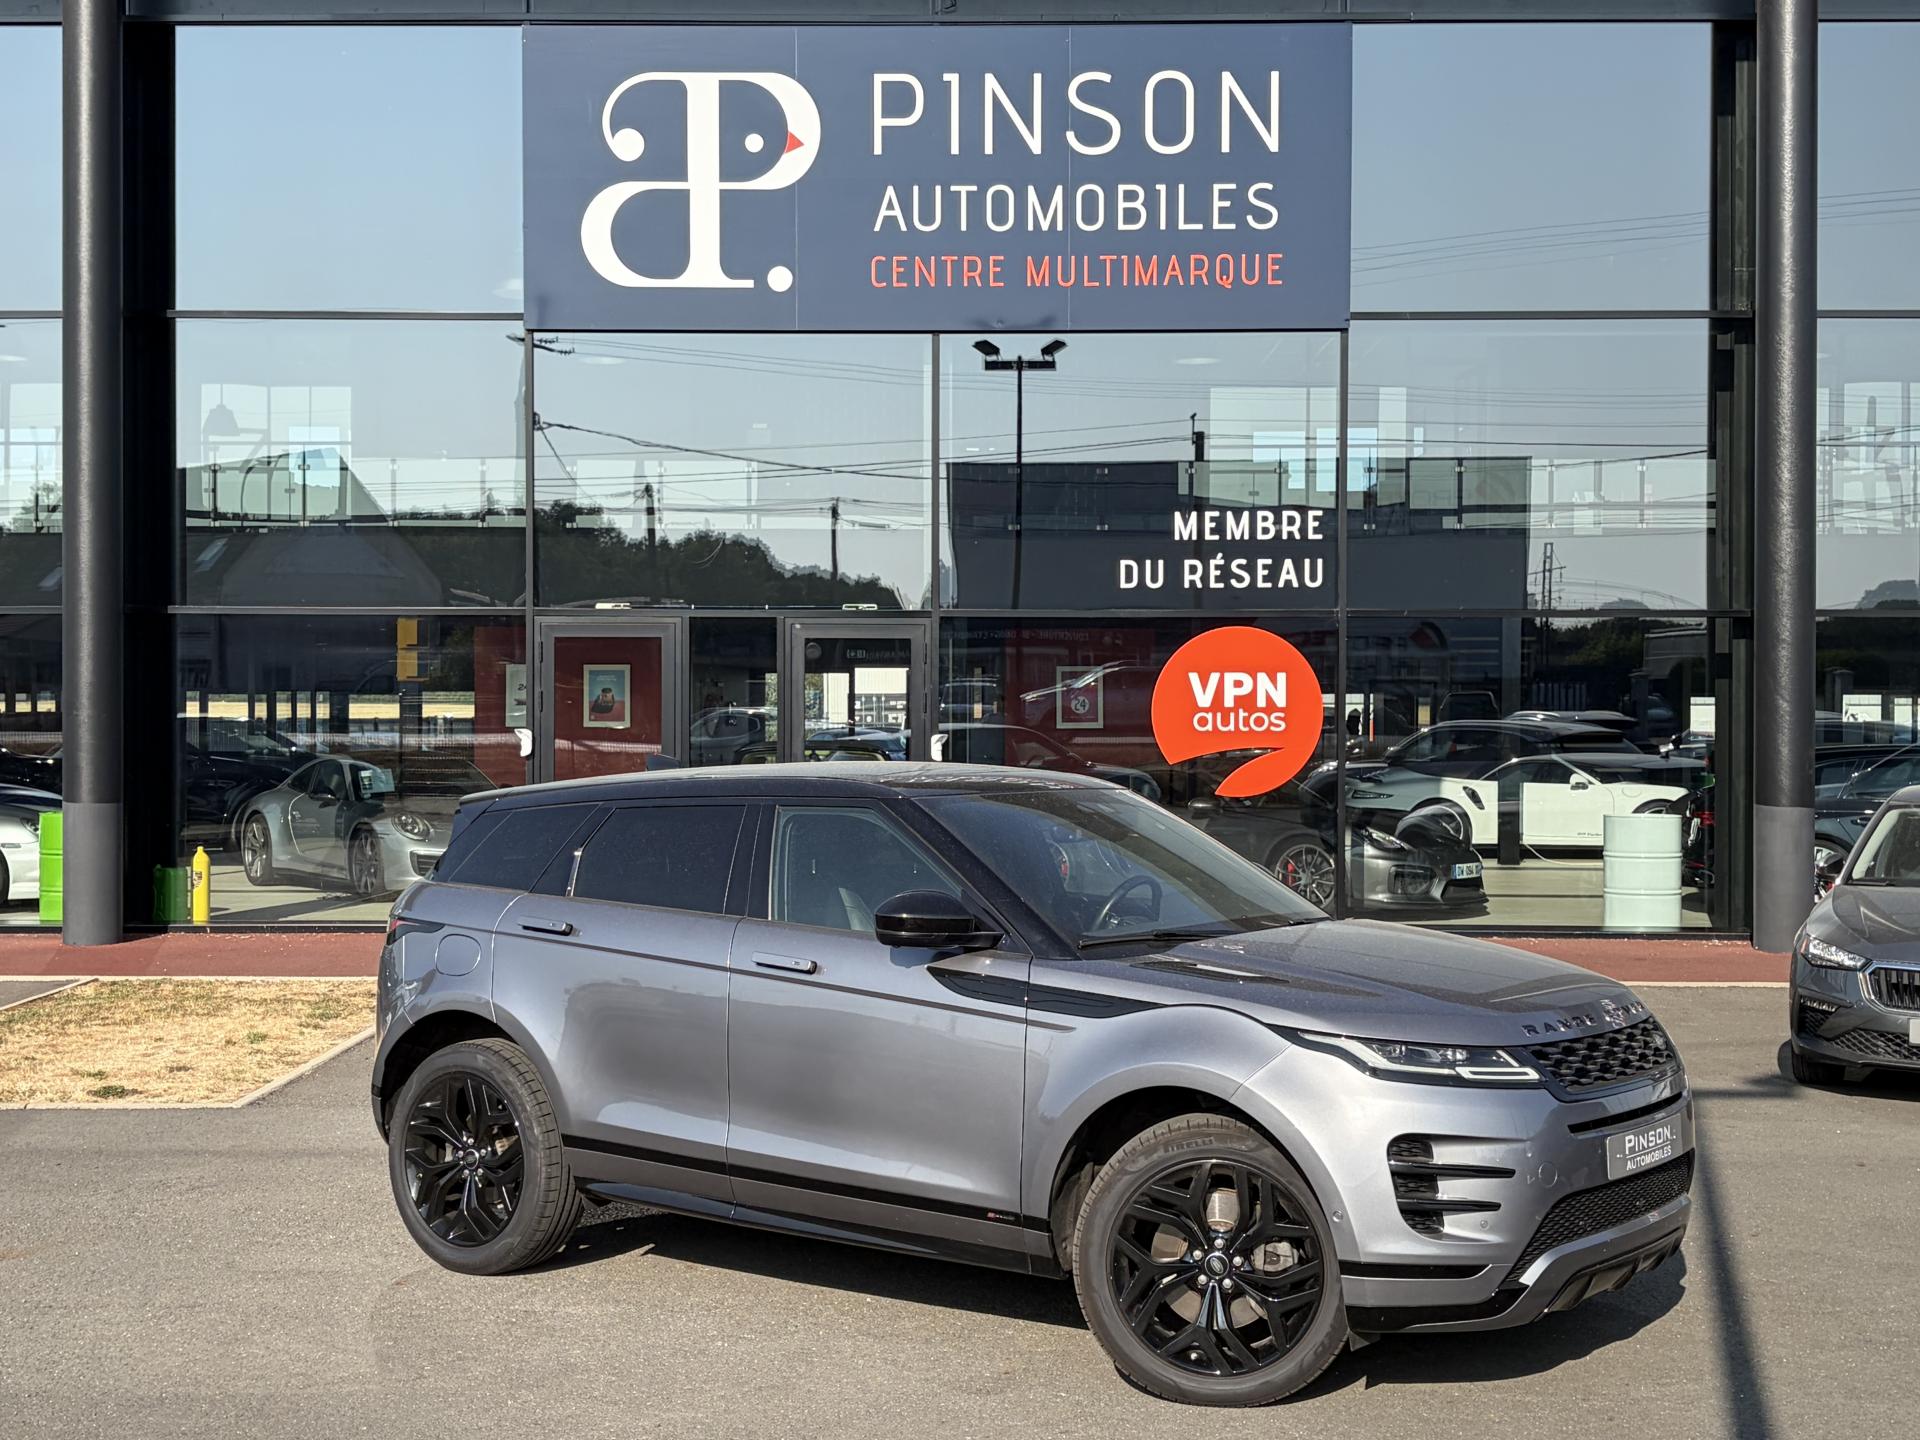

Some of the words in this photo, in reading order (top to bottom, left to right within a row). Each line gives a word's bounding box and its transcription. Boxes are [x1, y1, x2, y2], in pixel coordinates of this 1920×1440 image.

[873, 69, 1280, 156] PINSON
[873, 182, 1279, 233] AUTOMOBILES
[870, 254, 1005, 289] CENTRE
[1026, 253, 1283, 290] MULTIMARQUE
[1174, 510, 1323, 541] MEMBRE
[1119, 559, 1164, 589] DU
[1183, 552, 1323, 589] RÉSEAU
[1074, 698, 1086, 711] 24
[1188, 671, 1287, 708] VPN
[1192, 708, 1287, 732] autos
[1624, 1124, 1671, 1155] PINSON
[1626, 1145, 1672, 1171] AUTOMOBILES
